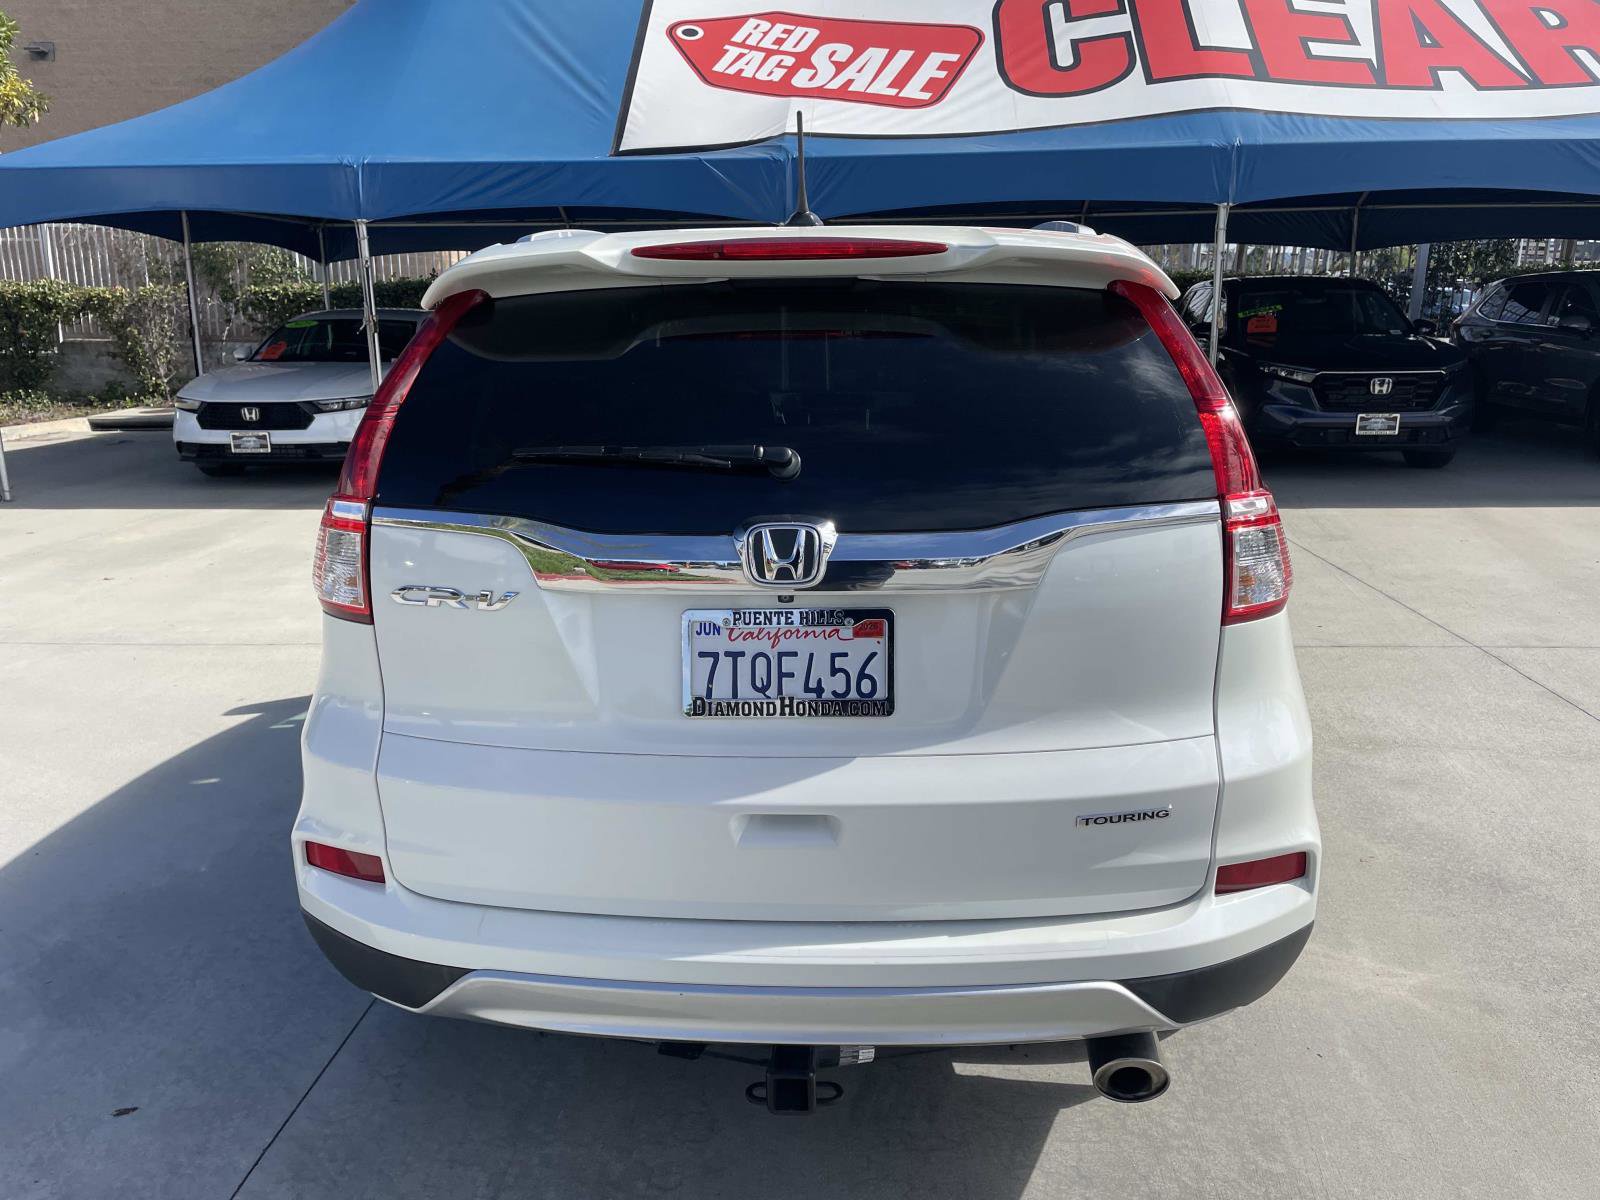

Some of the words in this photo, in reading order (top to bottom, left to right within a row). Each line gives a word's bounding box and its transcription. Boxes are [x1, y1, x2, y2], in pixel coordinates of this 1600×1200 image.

[731, 18, 820, 53] RED
[711, 45, 796, 81] TAG
[791, 43, 960, 100] SALE
[390, 585, 520, 611] CR-V
[695, 623, 721, 636] JUN
[732, 611, 795, 626] PUENTE
[800, 610, 845, 626] HILLS
[727, 628, 854, 649] California
[697, 651, 879, 699] 7TQF456
[1081, 809, 1170, 826] TOURING
